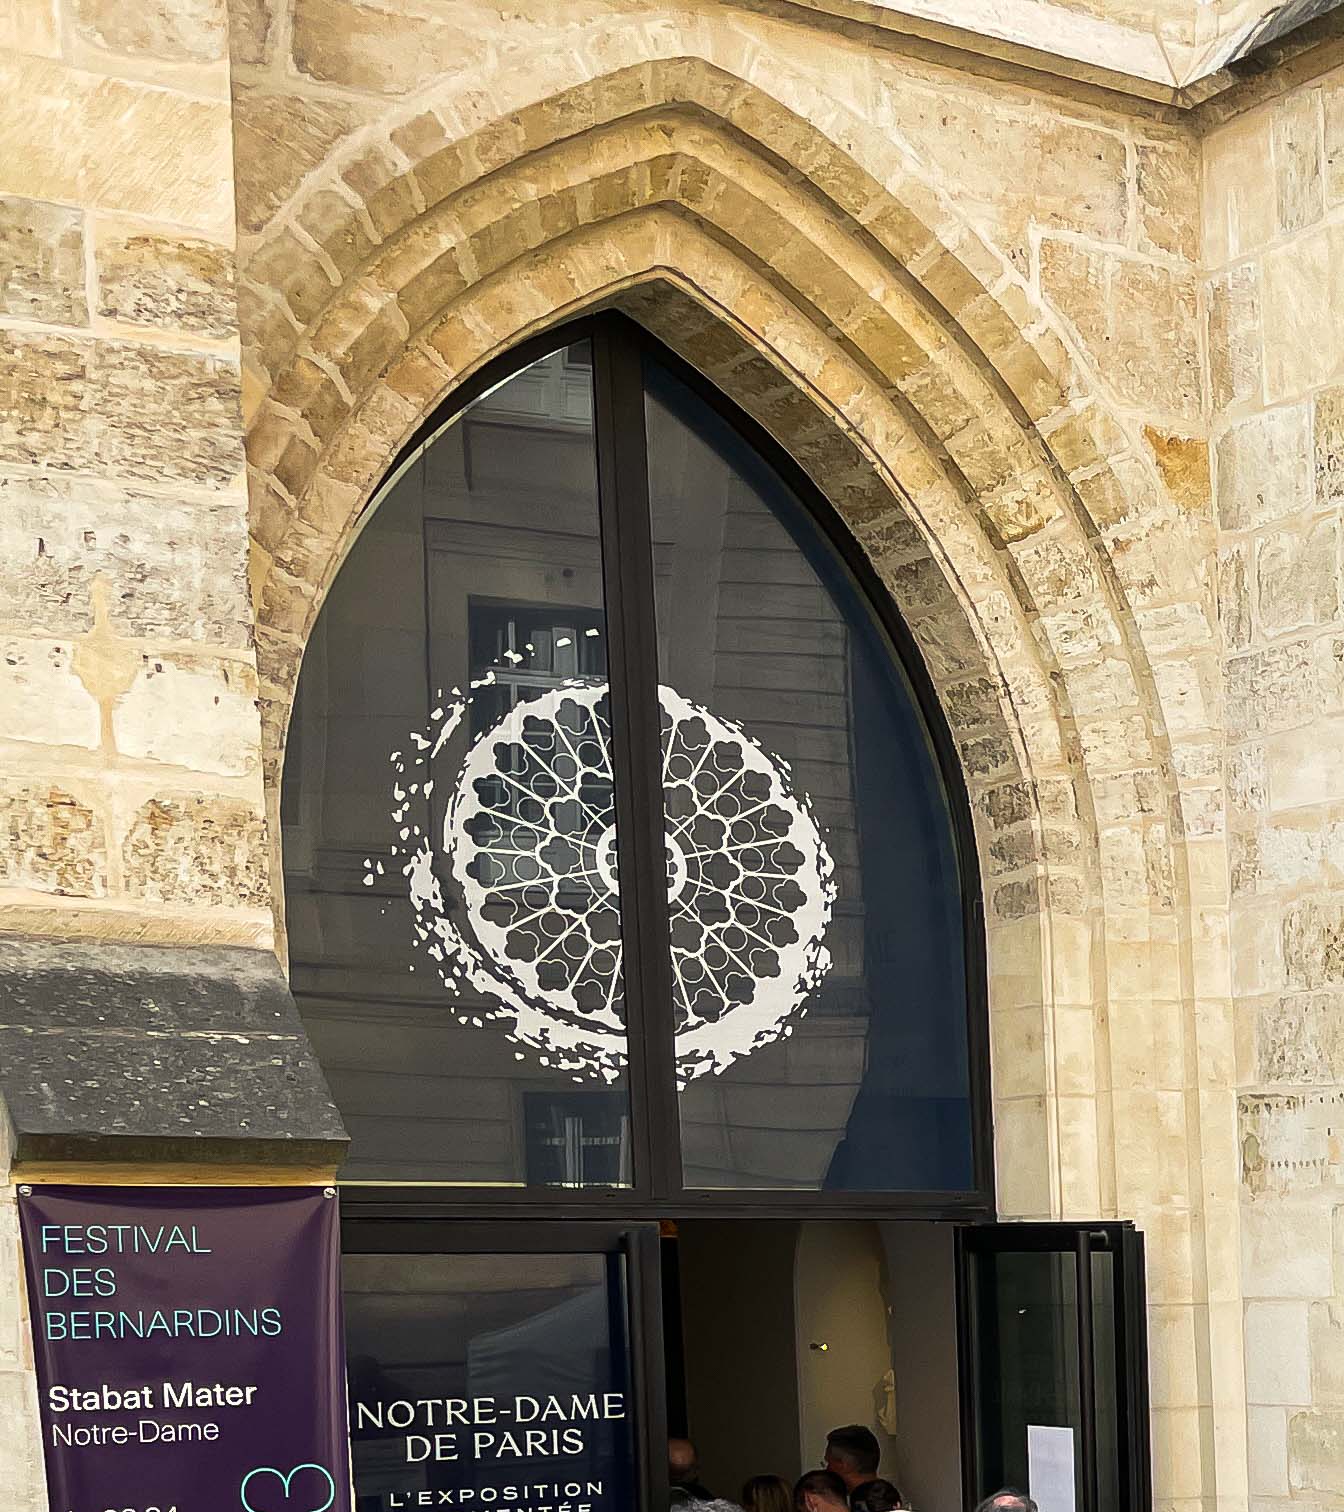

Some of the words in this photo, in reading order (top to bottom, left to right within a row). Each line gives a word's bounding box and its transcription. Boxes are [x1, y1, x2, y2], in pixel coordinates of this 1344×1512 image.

[41, 1225, 212, 1254] FESTIVAL
[43, 1268, 117, 1298] DES
[46, 1308, 282, 1341] BERNARDINS
[48, 1384, 153, 1413] Stabat
[163, 1382, 257, 1410] Mater
[357, 1393, 625, 1430] NOTRE-DAME
[52, 1420, 219, 1447] Notre-Dame
[406, 1434, 459, 1463] DE
[474, 1428, 584, 1459] PARIS
[390, 1481, 602, 1508] L'EXPOSITION
